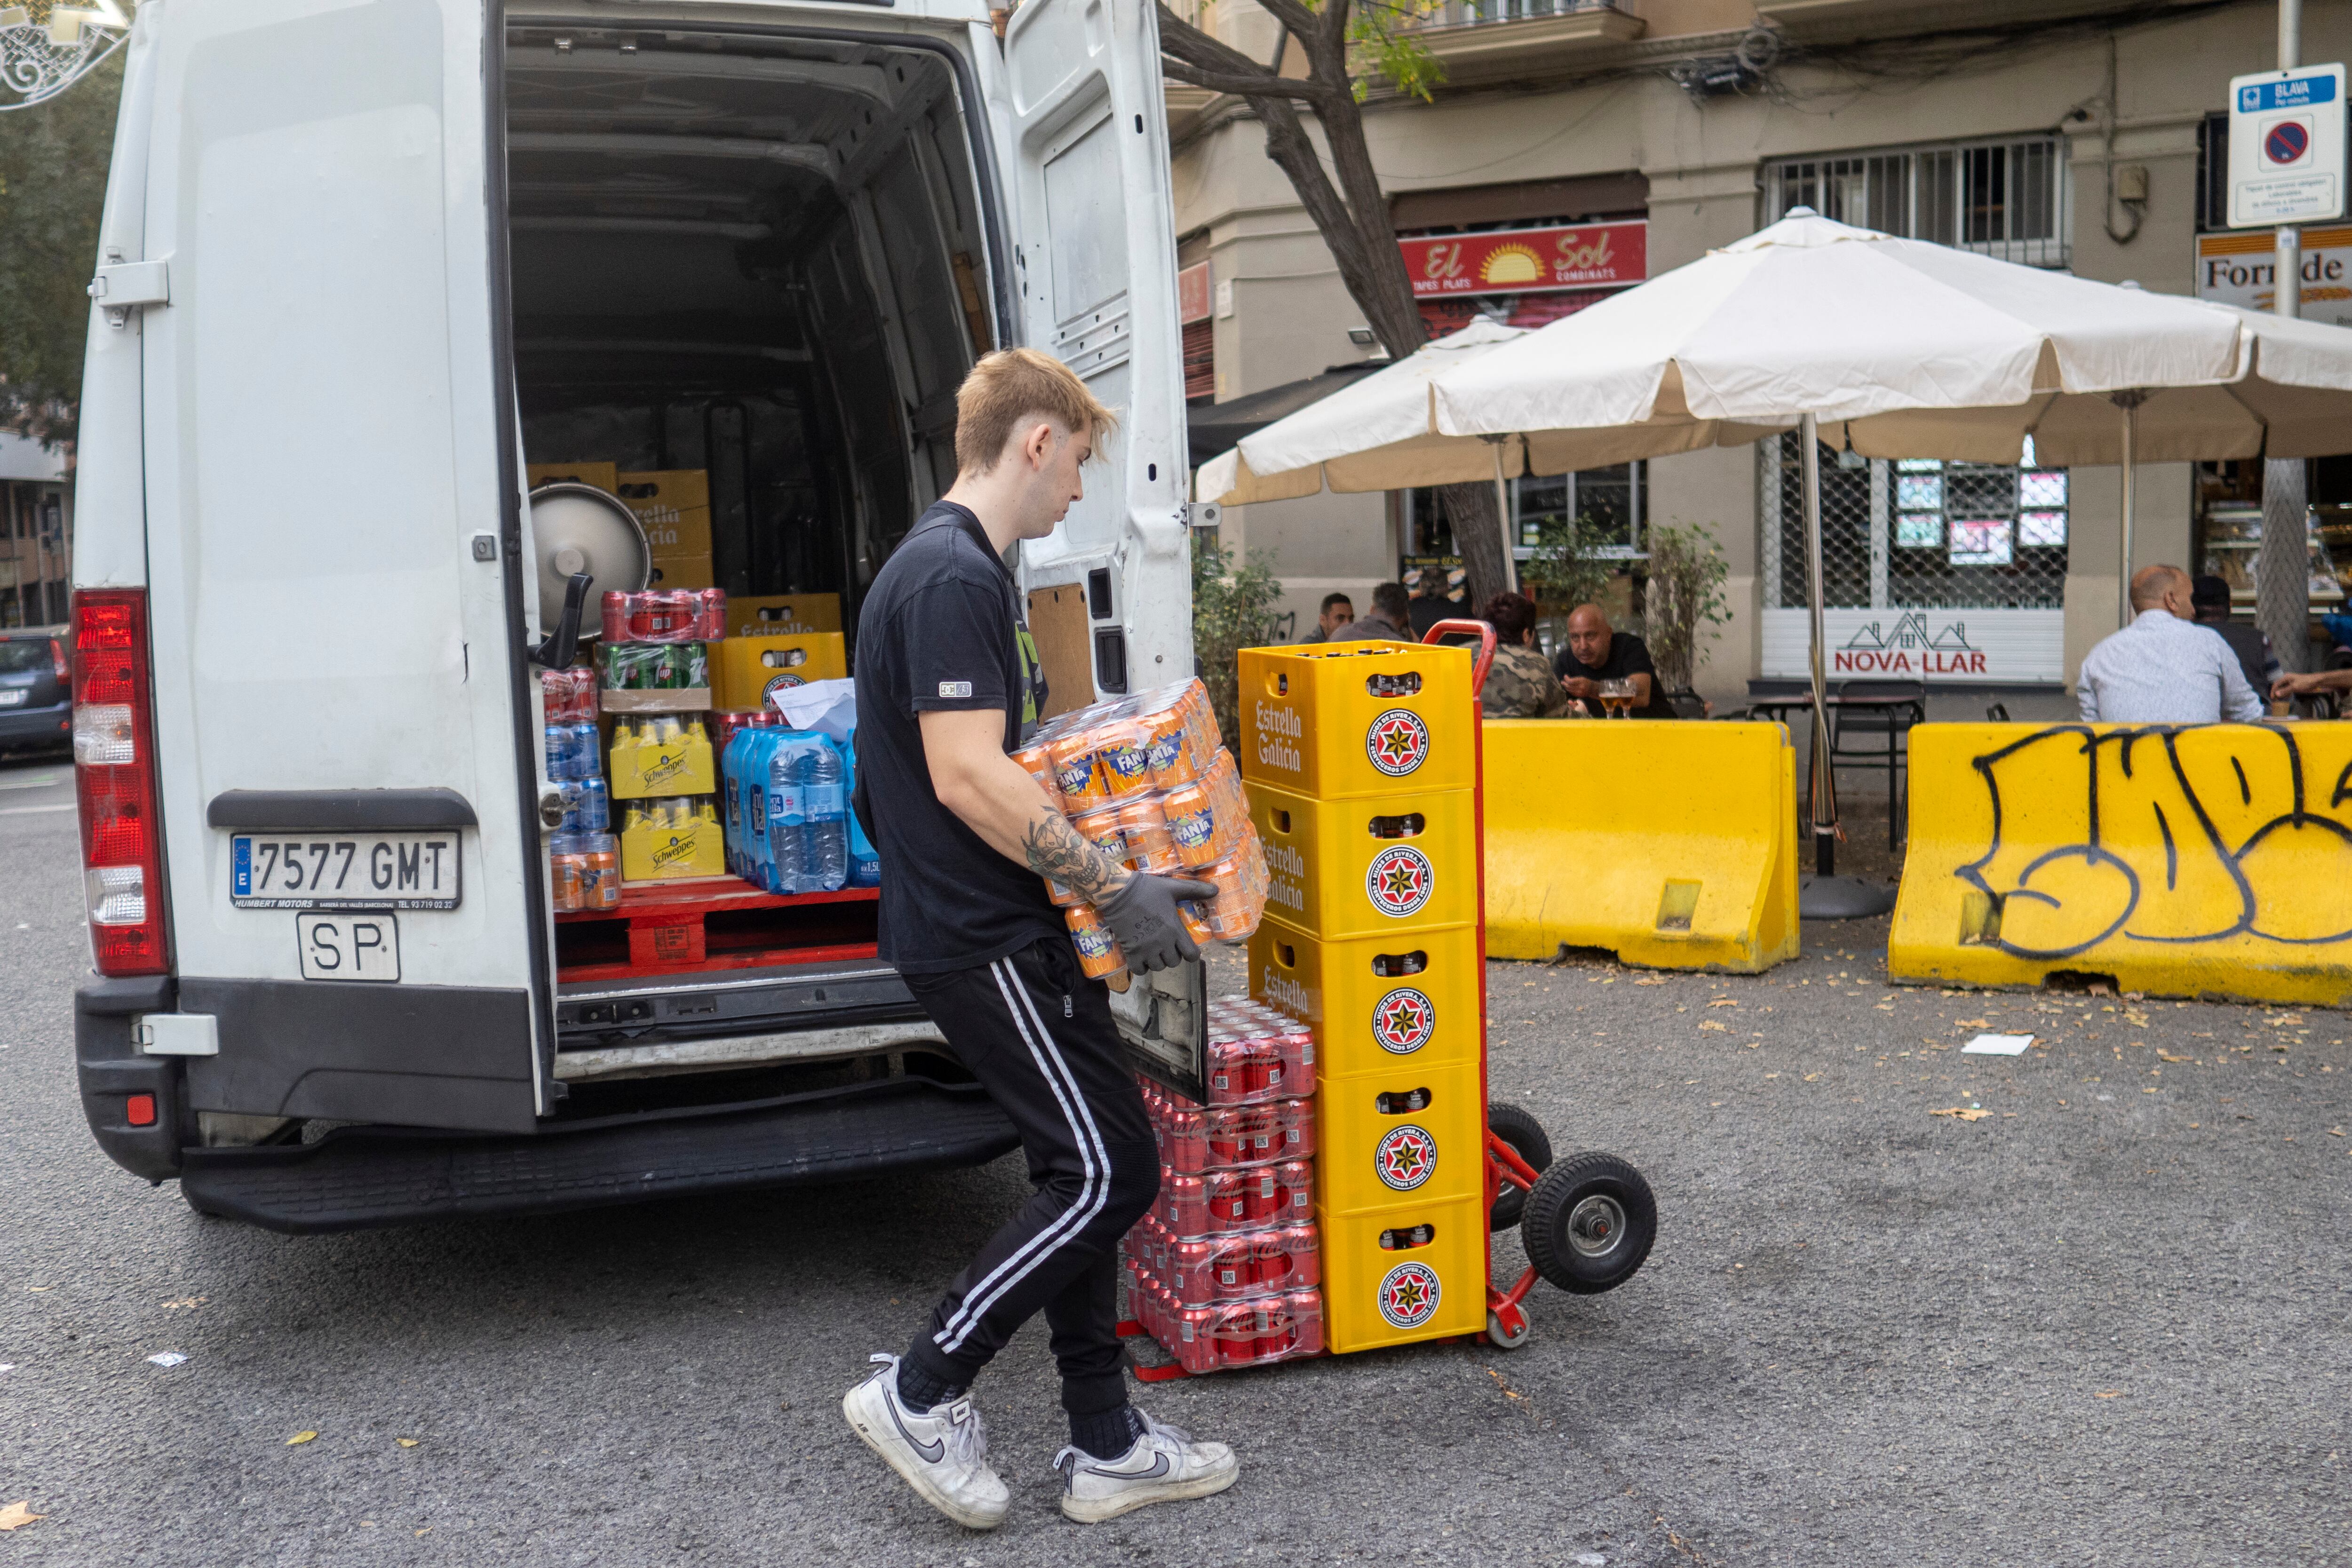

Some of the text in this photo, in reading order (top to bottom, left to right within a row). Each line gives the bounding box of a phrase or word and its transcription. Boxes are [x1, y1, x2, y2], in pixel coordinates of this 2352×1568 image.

[2275, 80, 2310, 97] BLAVA
[1424, 231, 1615, 278] El Sol
[2301, 253, 2343, 281] de
[1835, 650, 1987, 674] NOVA-LLAR
[1255, 699, 1302, 738] Estrella
[1371, 722, 1382, 739] HIJOS
[1258, 732, 1301, 773] Galicia
[1370, 746, 1399, 772] CERVECEROS
[1400, 758, 1418, 772] DESDE
[1058, 768, 1087, 788] ANTA
[1176, 819, 1211, 841] FANTA
[259, 842, 447, 890] 7577 GMT
[653, 839, 695, 869] Schweppes
[238, 873, 247, 886] E
[1373, 860, 1385, 878] HIJOS
[277, 899, 313, 908] MOTORS
[1373, 885, 1401, 911] CERVECEROS
[1403, 897, 1421, 910] DESDE
[1078, 933, 1108, 951] FAN
[1264, 965, 1308, 1013] Estrella
[1377, 1002, 1388, 1019] HIJOS
[1376, 1026, 1405, 1050] CERVECEROS
[1406, 1037, 1424, 1049] DESDE
[1380, 1140, 1390, 1157] HIJOS
[1379, 1163, 1408, 1187] CERVECEROS
[1409, 1173, 1426, 1186] DESDE
[856, 1423, 869, 1433] AIR
